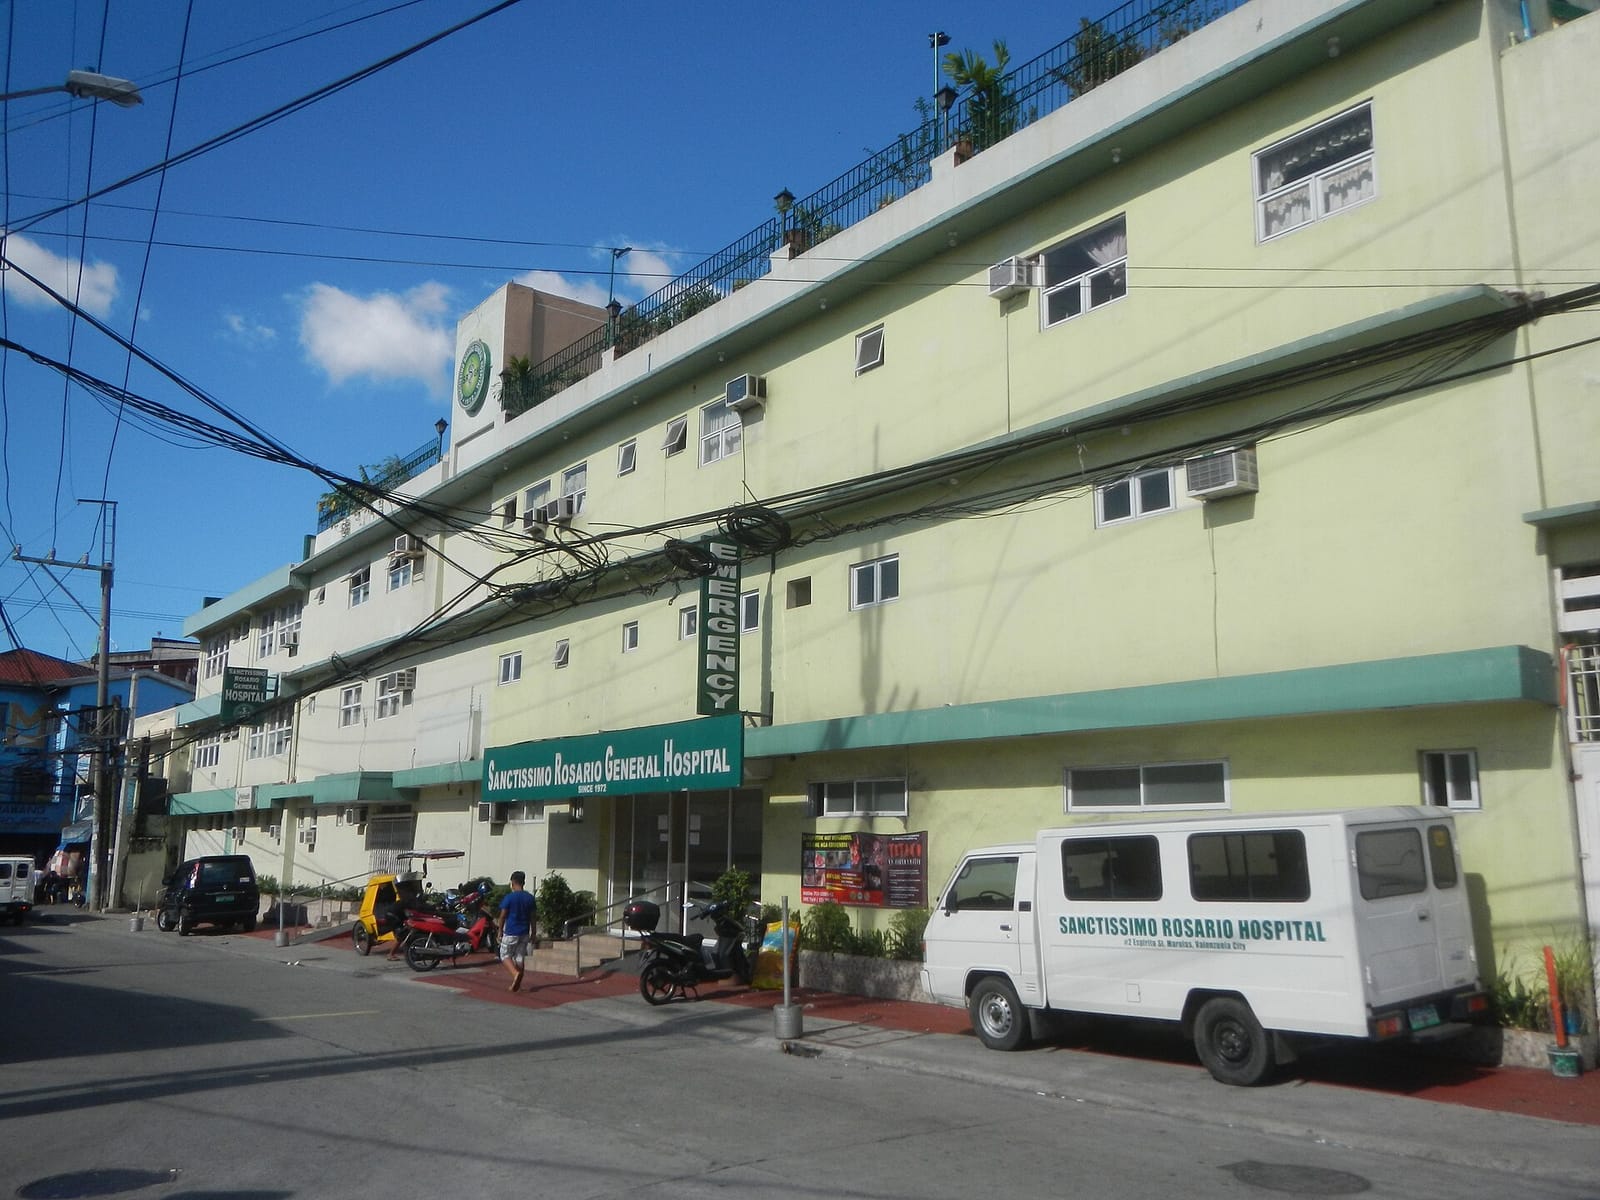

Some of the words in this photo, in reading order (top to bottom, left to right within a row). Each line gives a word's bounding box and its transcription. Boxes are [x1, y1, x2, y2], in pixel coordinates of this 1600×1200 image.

[705, 542, 738, 709] EMERGENCY
[225, 689, 265, 702] HOSPITAL
[487, 759, 552, 791] SANCTISSIMO
[554, 752, 602, 785] ROSARIO
[604, 745, 661, 781] GENERAL
[663, 739, 731, 777] HOSPITAL
[578, 785, 593, 793] SINCE
[594, 784, 607, 792] 1972
[1059, 916, 1158, 937] SANCTISSIMO
[1162, 918, 1234, 939] ROSARIO
[1238, 919, 1327, 942] HOSPITAL
